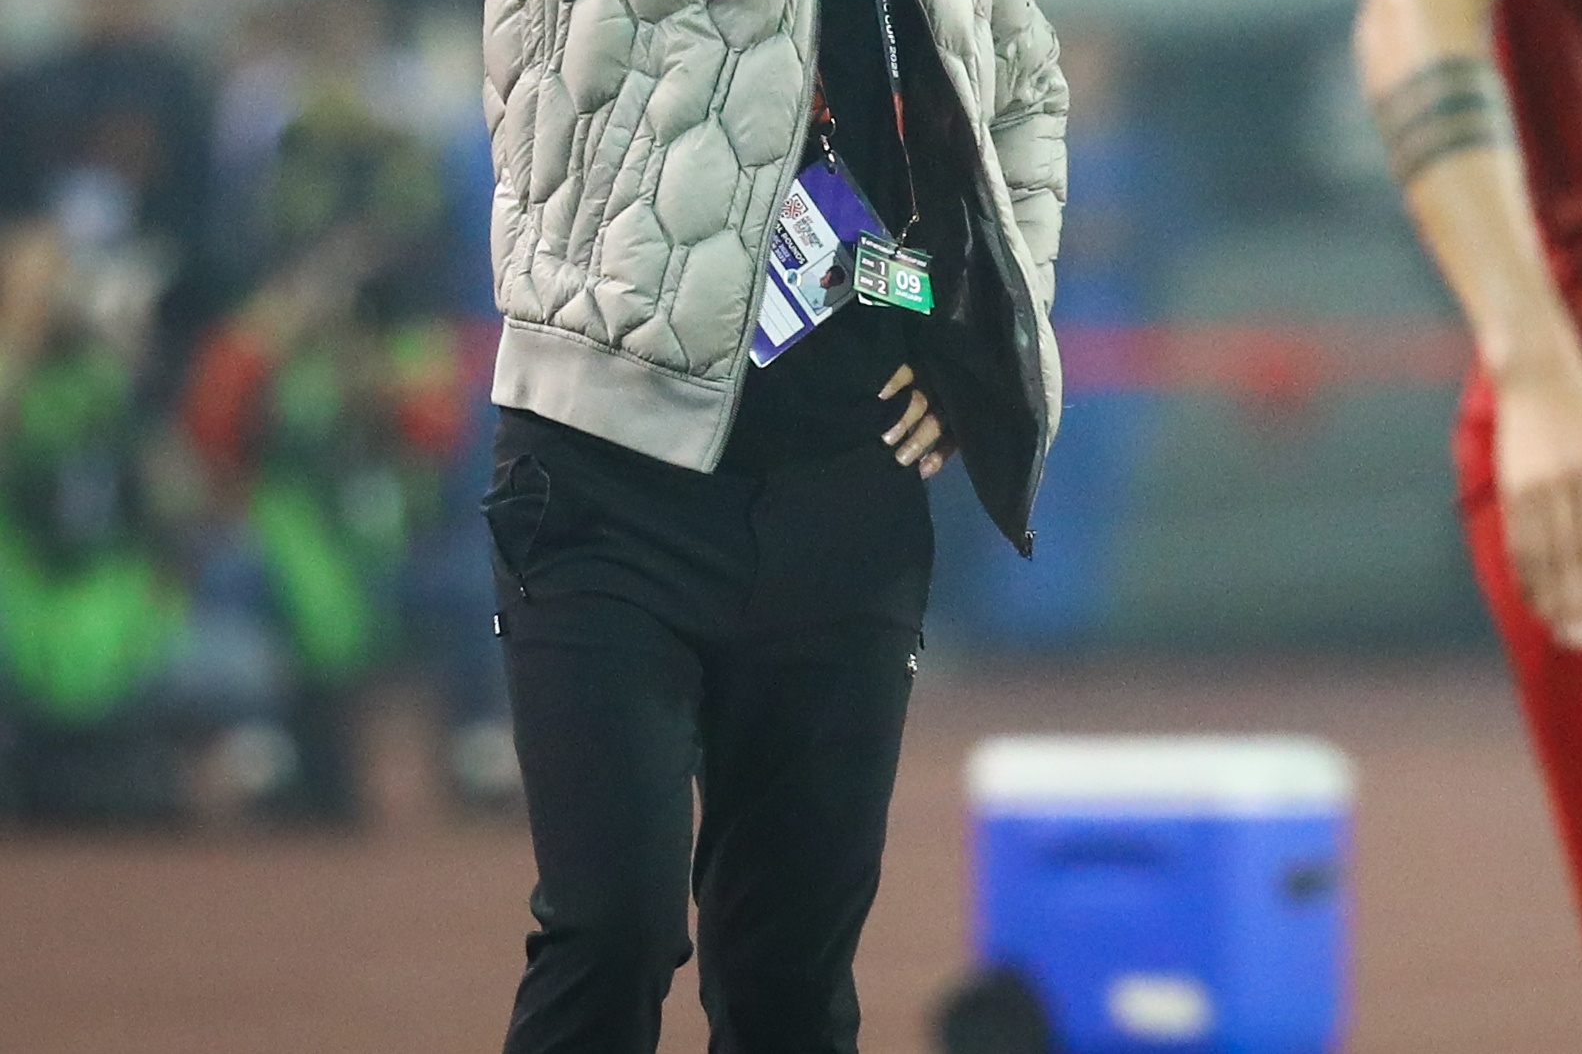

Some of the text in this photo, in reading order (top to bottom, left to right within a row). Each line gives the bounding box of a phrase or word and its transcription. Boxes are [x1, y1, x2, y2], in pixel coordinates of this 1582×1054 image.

[884, 14, 896, 44] CUP
[879, 261, 886, 276] 1
[877, 279, 887, 295] 2
[896, 270, 921, 294] 09
